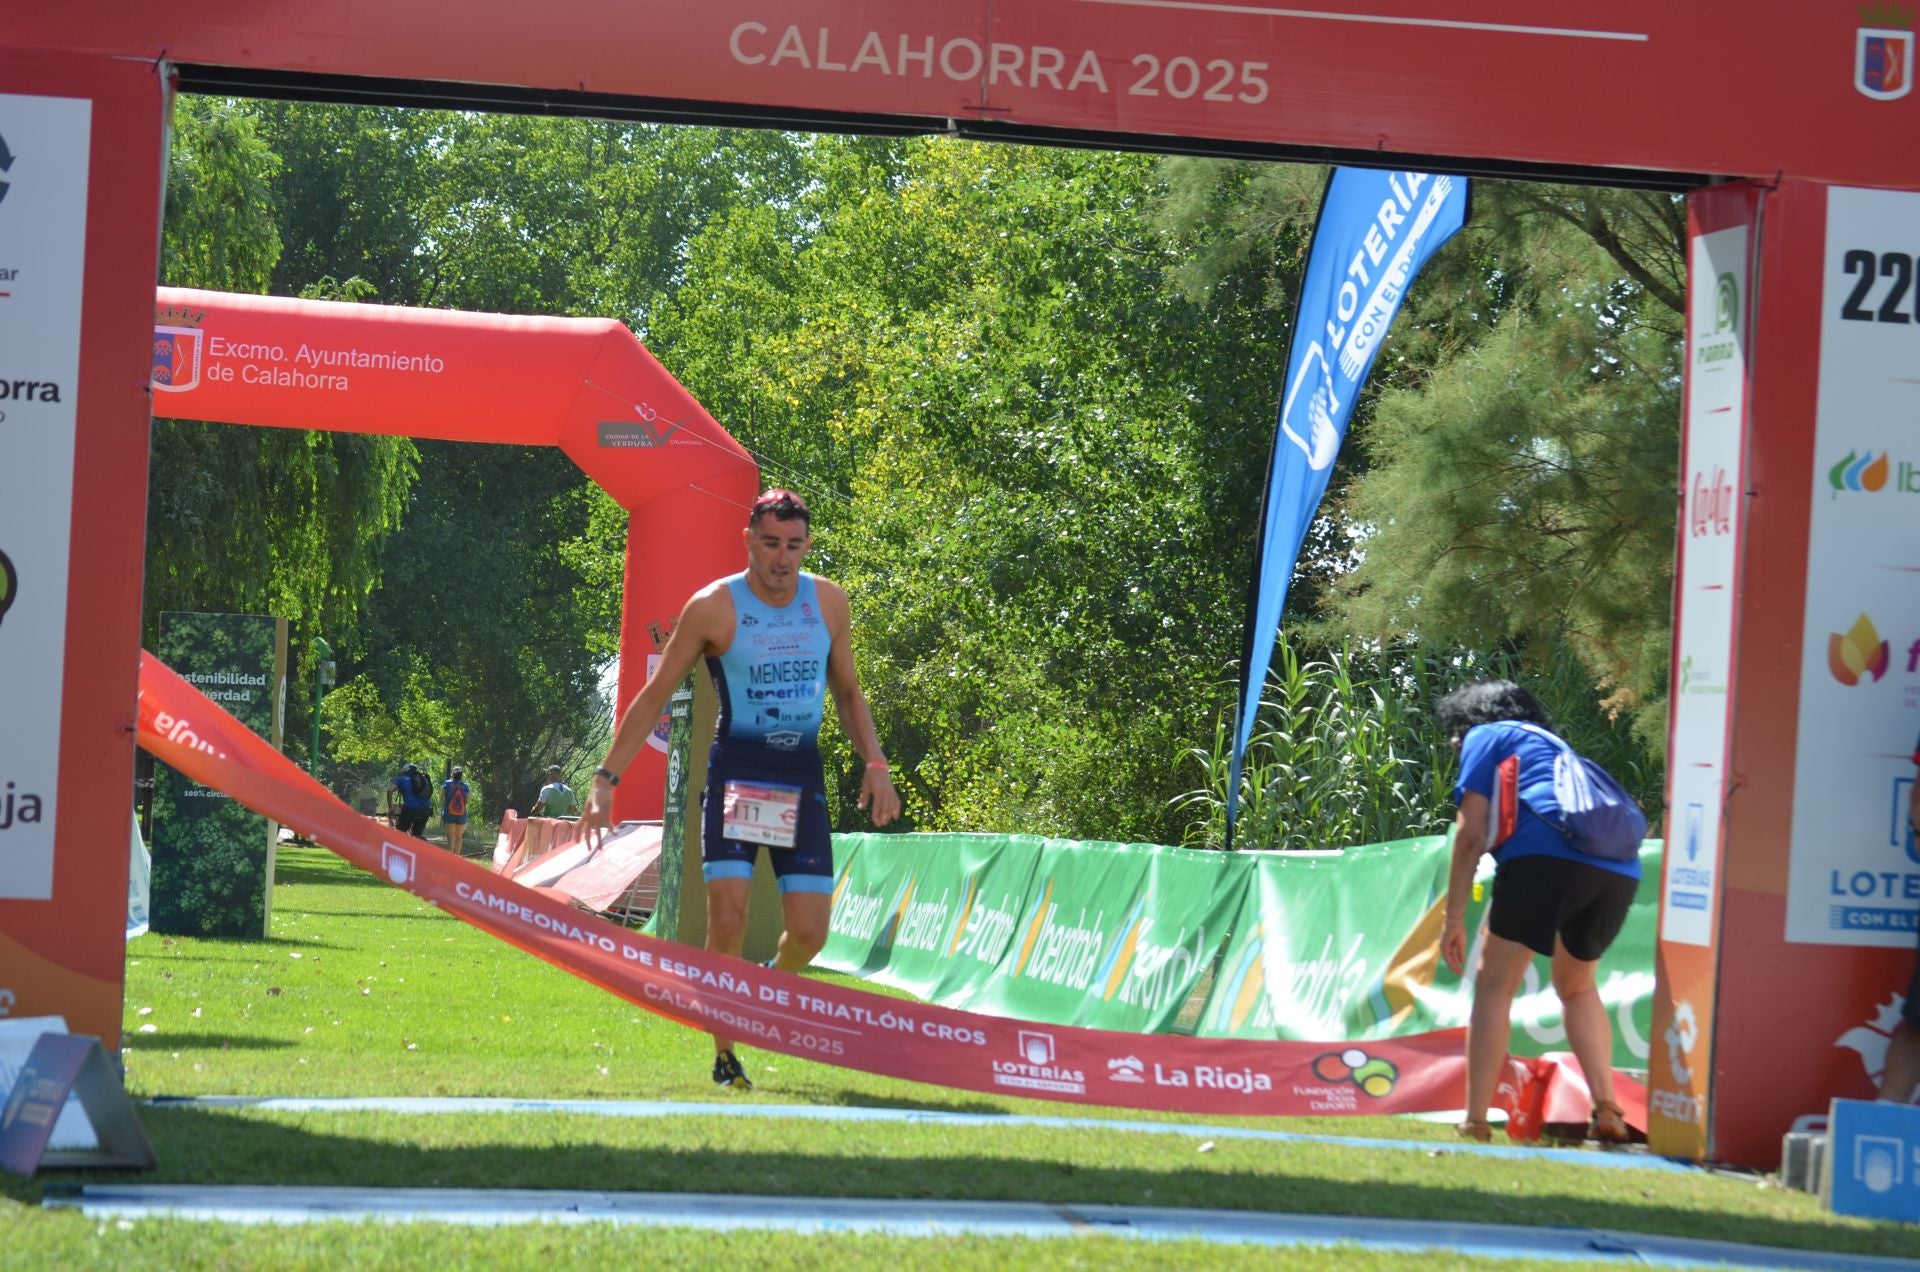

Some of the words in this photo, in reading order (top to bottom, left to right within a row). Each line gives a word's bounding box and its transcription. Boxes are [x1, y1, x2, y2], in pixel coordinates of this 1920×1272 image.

[729, 21, 1109, 93] CALAHORRA
[1128, 53, 1269, 104] 2025
[1841, 249, 1920, 325] 22
[1355, 308, 1386, 349] CON
[209, 336, 288, 362] Excmo.
[294, 343, 444, 373] Ayuntamiento
[207, 362, 234, 382] de
[242, 364, 348, 391] Calahorra
[750, 660, 820, 685] MENESES
[745, 684, 817, 699] tenerife
[0, 781, 42, 829] ja
[184, 790, 205, 798] 100%
[206, 789, 233, 798] circu
[1848, 911, 1884, 925] CON
[455, 881, 616, 952] CAMPEONATO
[622, 945, 653, 965] DE
[659, 958, 751, 997] ESPAÑA
[759, 985, 790, 1007] DE
[797, 994, 915, 1034] TRIATLÓN
[921, 1021, 986, 1046] CROS
[643, 982, 782, 1042] CALAHORRA
[789, 1030, 845, 1056] 2025
[992, 1060, 1085, 1082] LOTERÍAS
[1154, 1063, 1189, 1087] La
[1195, 1066, 1272, 1094] Rioja
